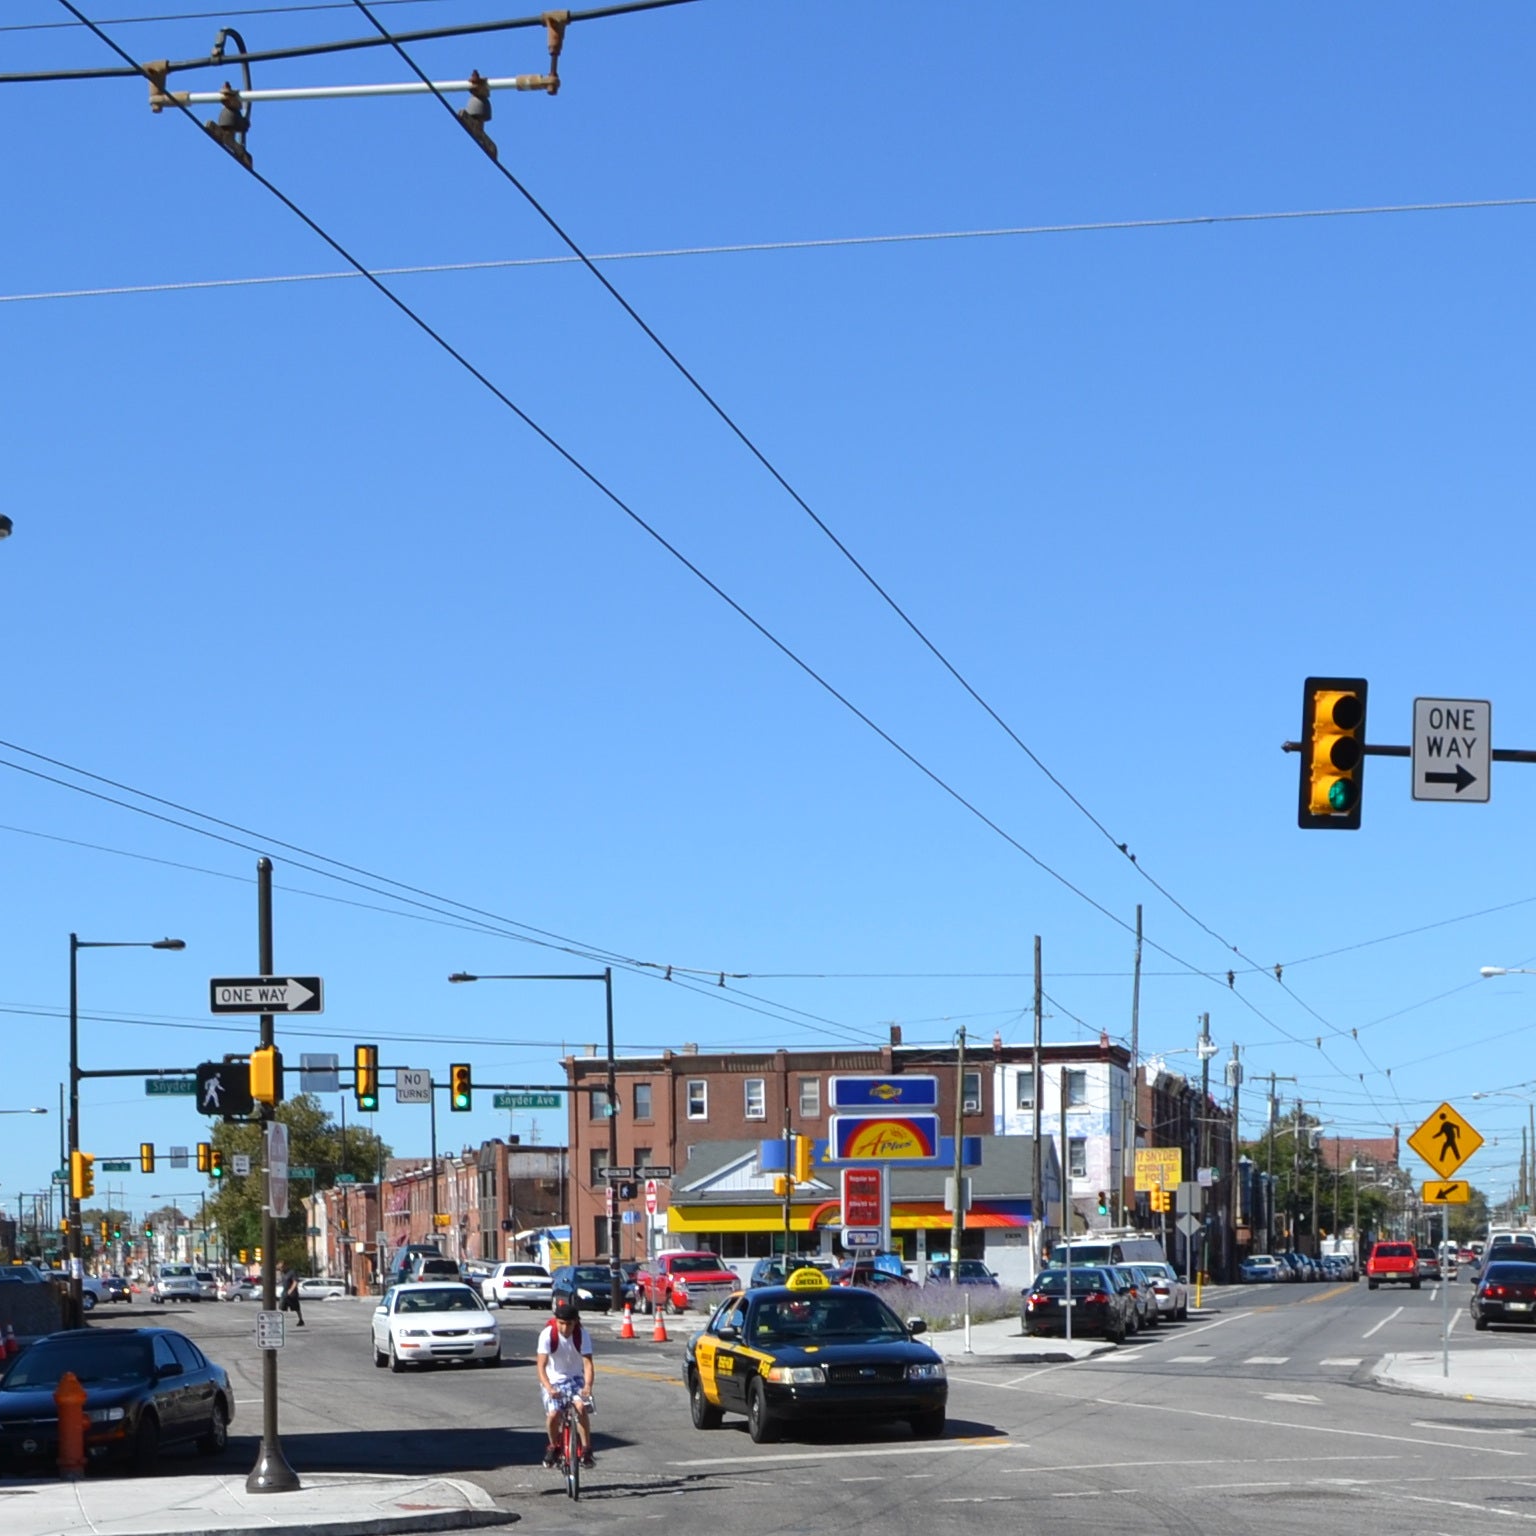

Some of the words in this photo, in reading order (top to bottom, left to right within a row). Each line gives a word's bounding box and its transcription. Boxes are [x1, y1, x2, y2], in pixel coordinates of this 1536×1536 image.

[1429, 708, 1475, 731] ONE
[1427, 737, 1477, 759] WAY
[222, 989, 252, 1002] ONE
[259, 988, 286, 1002] WAY
[404, 1074, 421, 1085] NO
[153, 1081, 192, 1093] Snyder
[398, 1089, 429, 1099] TURNS
[500, 1094, 533, 1106] Snyder
[538, 1095, 555, 1105] Ave
[1145, 1150, 1179, 1161] SNYDER
[1137, 1164, 1177, 1172] CHINSE
